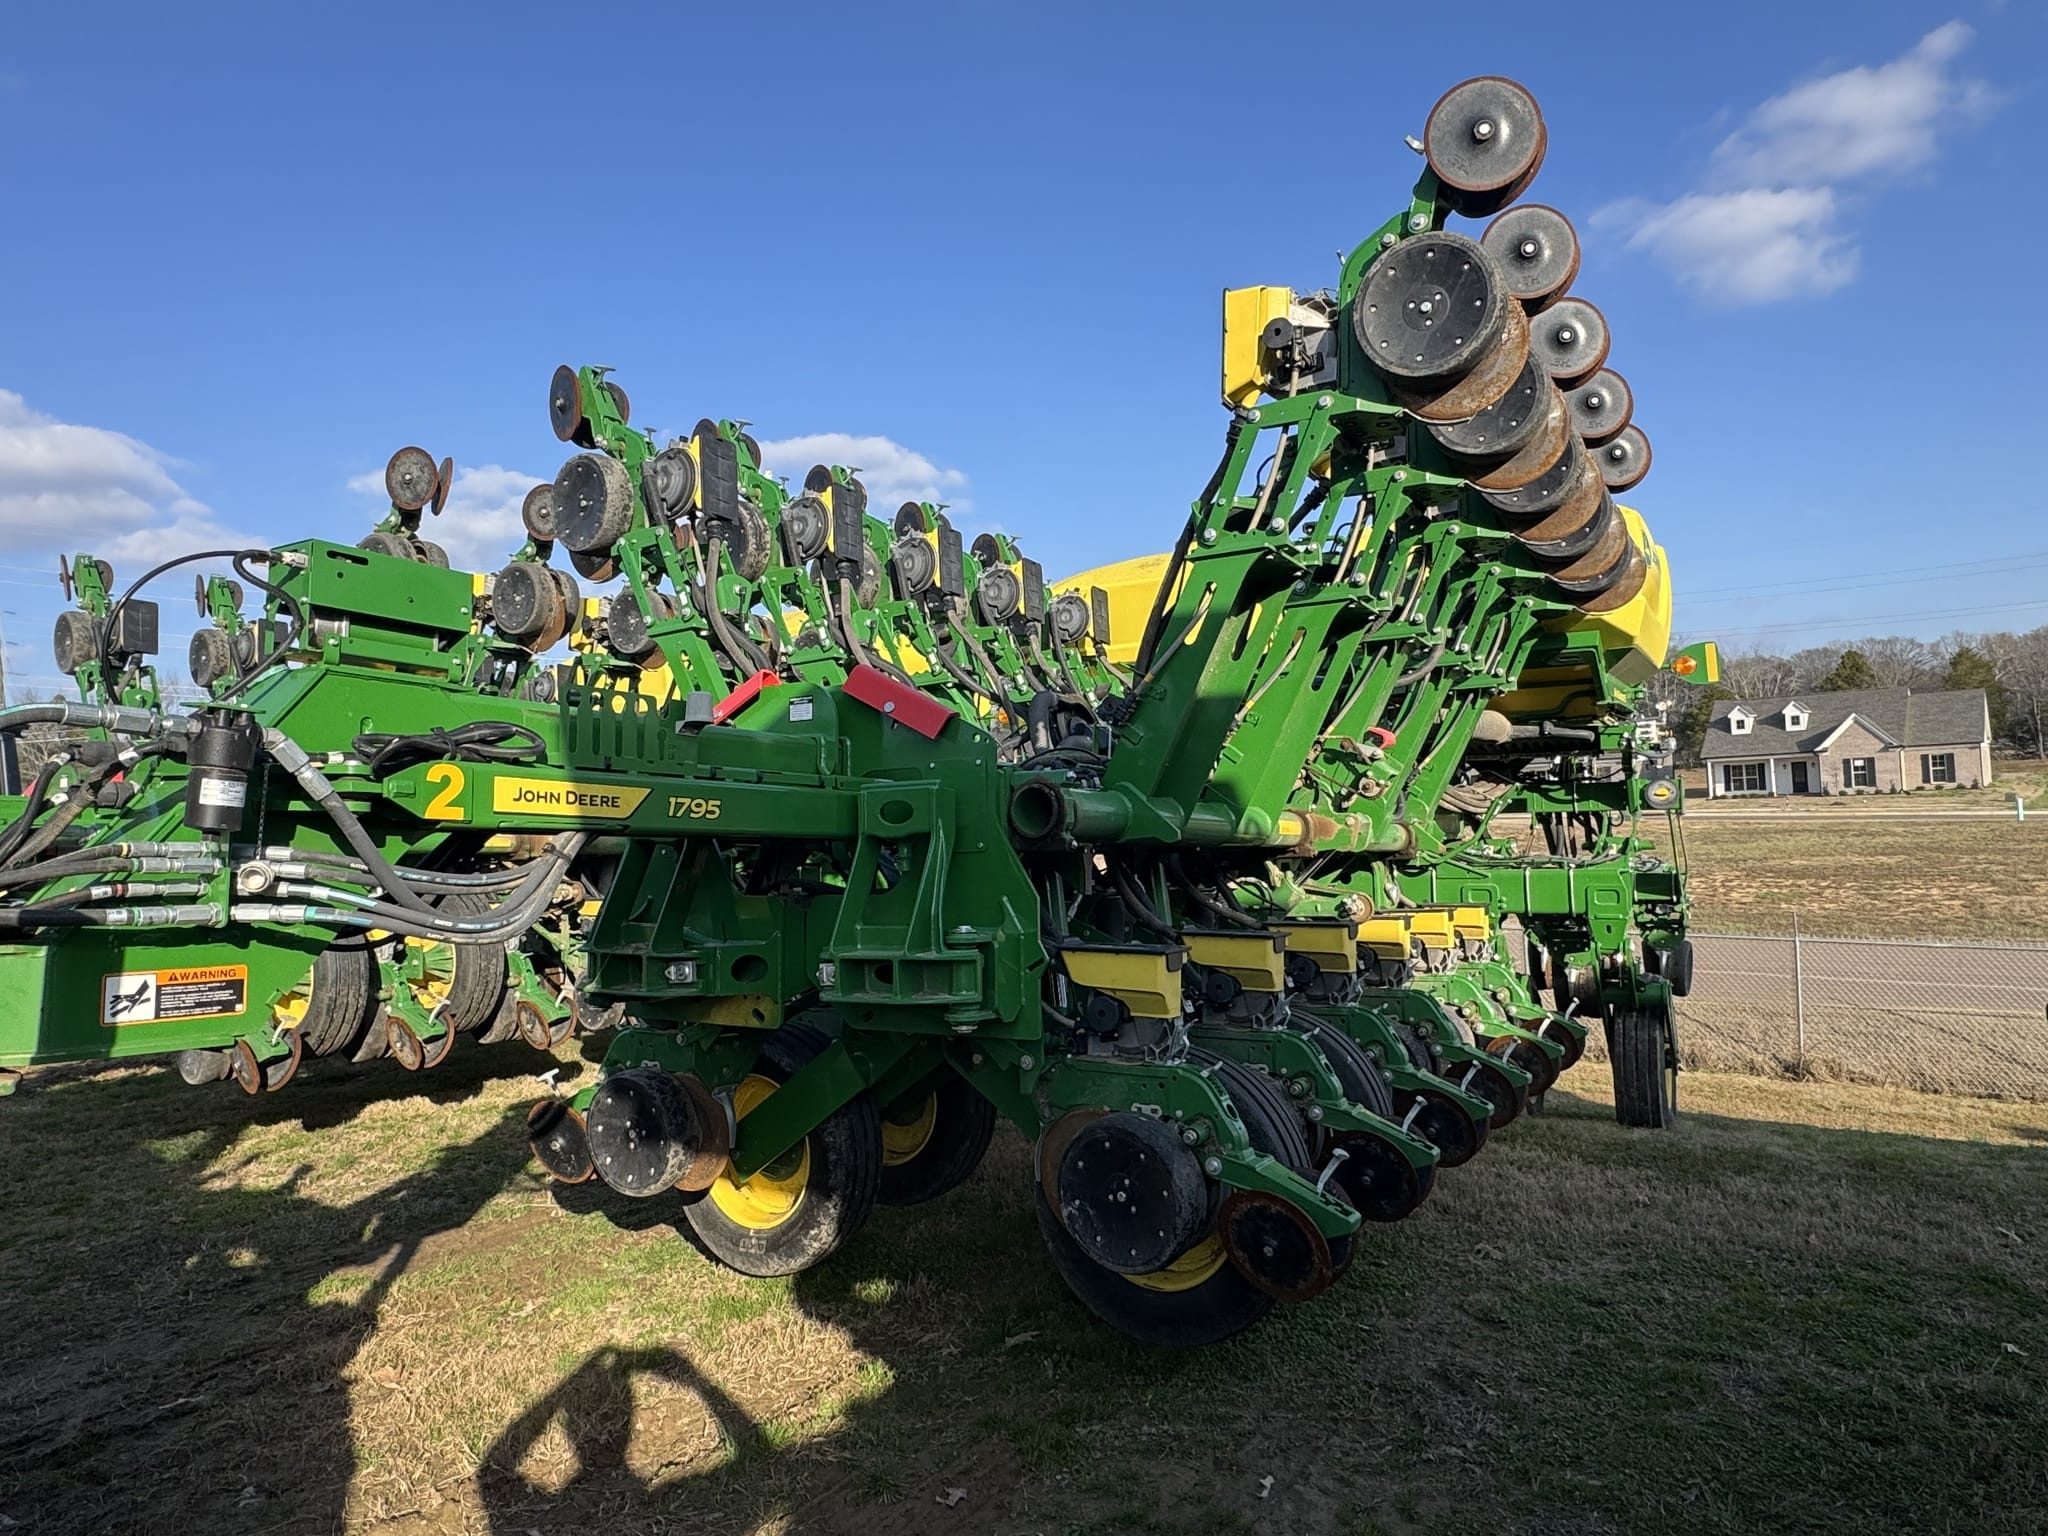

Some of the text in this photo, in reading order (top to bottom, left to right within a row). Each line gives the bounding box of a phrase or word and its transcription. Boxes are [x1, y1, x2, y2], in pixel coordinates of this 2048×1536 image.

[424, 763, 465, 821] 2
[513, 787, 620, 808] JOHN DEERE
[667, 796, 722, 820] 1795
[180, 968, 236, 981] WARNING
